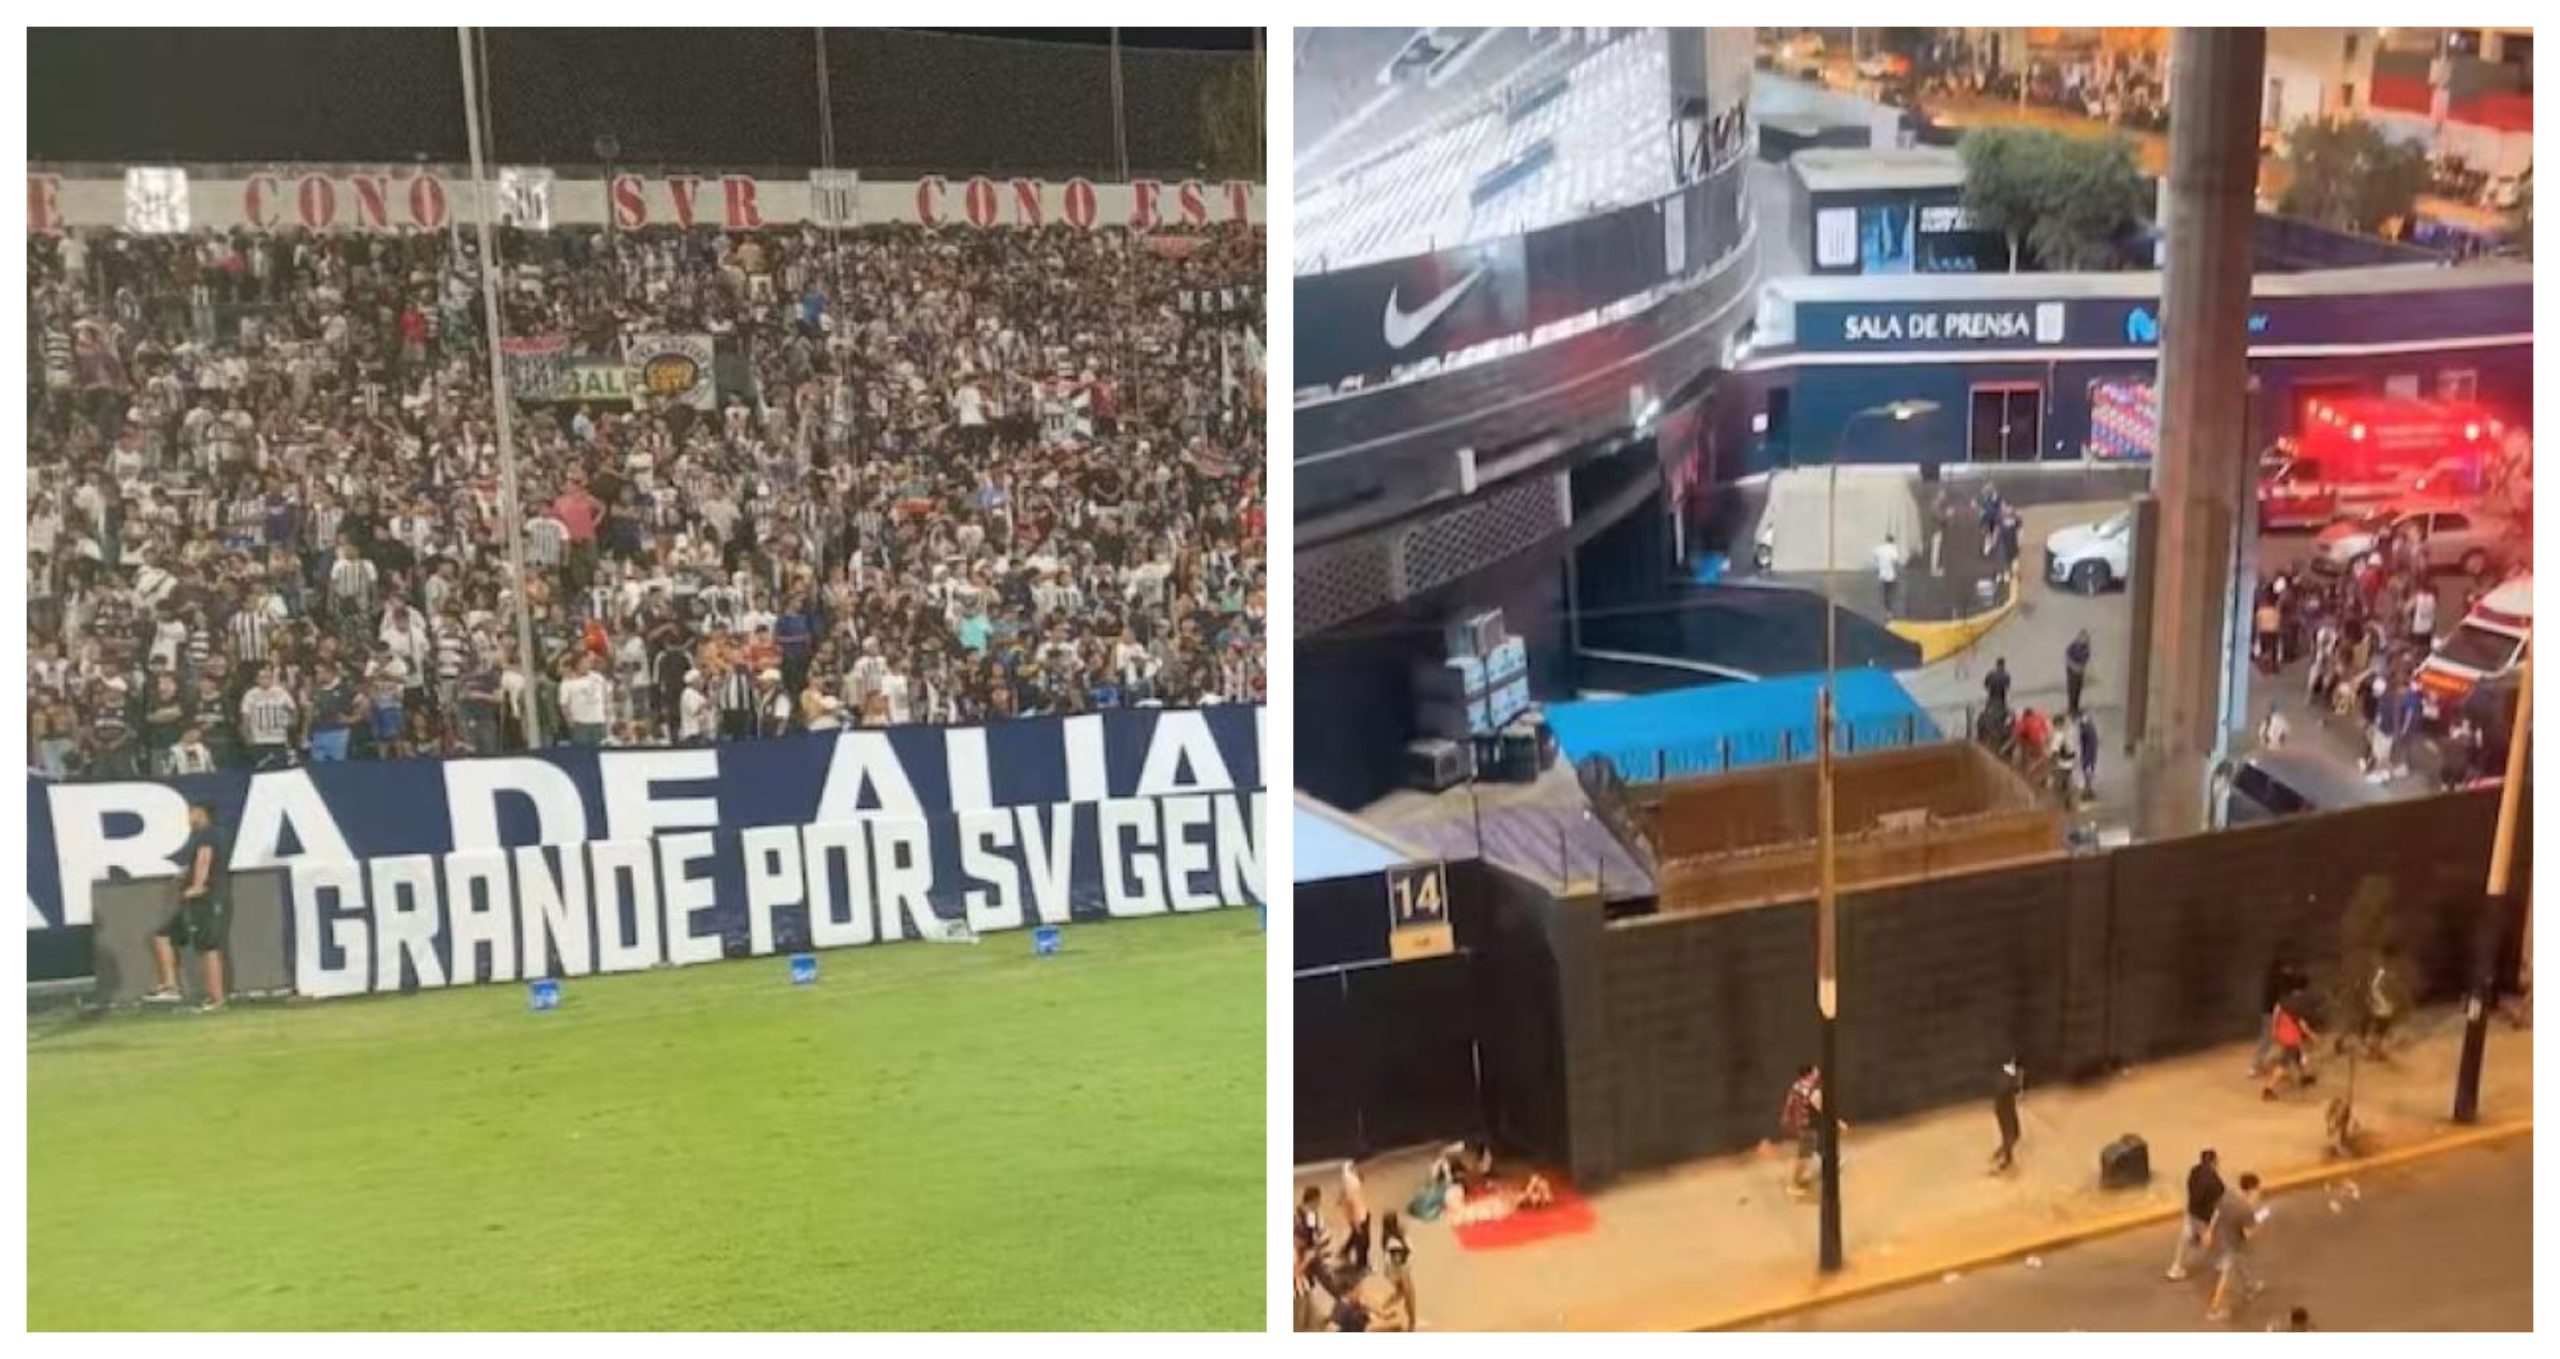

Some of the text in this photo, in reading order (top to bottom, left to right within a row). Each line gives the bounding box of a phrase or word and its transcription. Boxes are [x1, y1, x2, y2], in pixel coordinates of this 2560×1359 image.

[244, 172, 764, 236] CONO SVR
[917, 175, 1098, 230] CONO
[1845, 312, 2030, 339] SALA DE PRENSA
[28, 769, 359, 927] RA
[815, 709, 1267, 822] ALIA
[290, 790, 1267, 997] GRANDE POR SV GEN
[1394, 871, 1441, 919] 14
